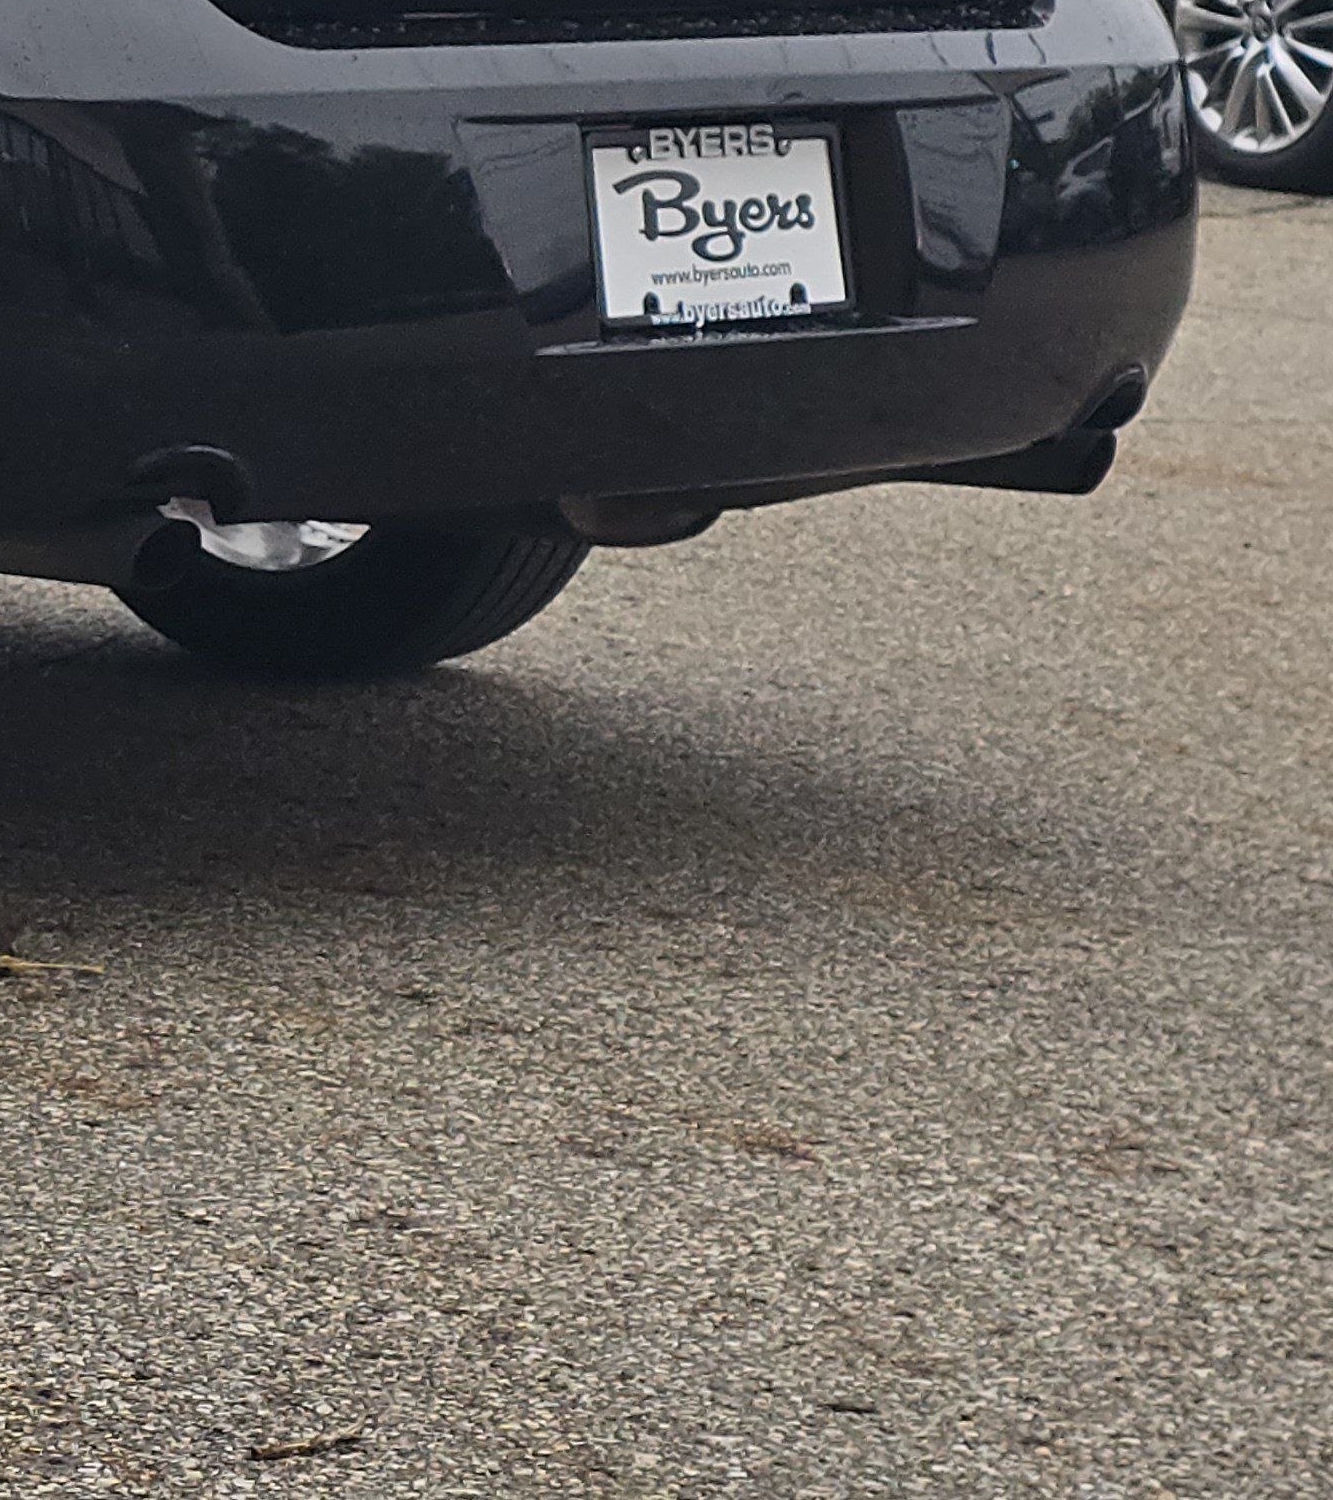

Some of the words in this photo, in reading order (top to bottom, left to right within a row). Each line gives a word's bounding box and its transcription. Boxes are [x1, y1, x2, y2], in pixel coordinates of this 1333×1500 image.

[649, 123, 775, 159] BYERS
[612, 170, 815, 262] Byers
[651, 261, 792, 287] www.byersauto.com
